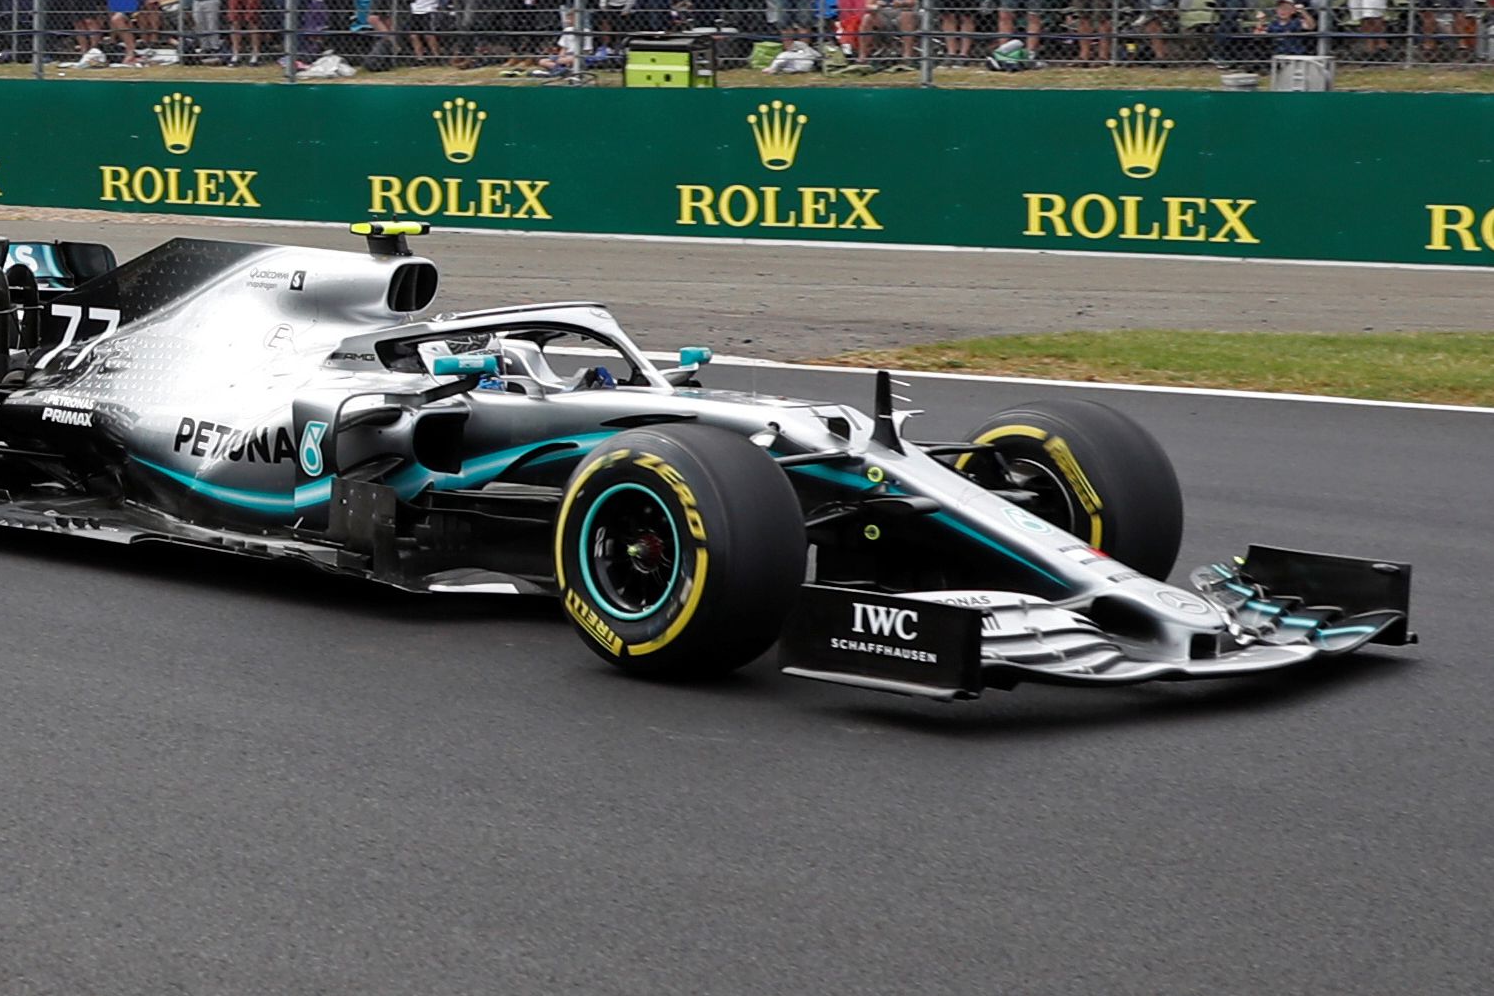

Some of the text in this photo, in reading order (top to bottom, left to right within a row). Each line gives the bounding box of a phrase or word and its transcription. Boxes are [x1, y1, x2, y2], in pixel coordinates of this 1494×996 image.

[101, 166, 260, 207] ROLEX
[370, 176, 551, 219] ROLEX
[677, 185, 883, 230] ROLEX
[1024, 194, 1259, 244] ROLEX
[34, 303, 121, 371] 77
[41, 407, 94, 428] PRIMAX
[46, 394, 96, 410] PETRONAS
[564, 587, 624, 658] PIRELLI
[851, 602, 919, 641] IWC
[830, 637, 938, 664] SCHAFFHAUSEN
